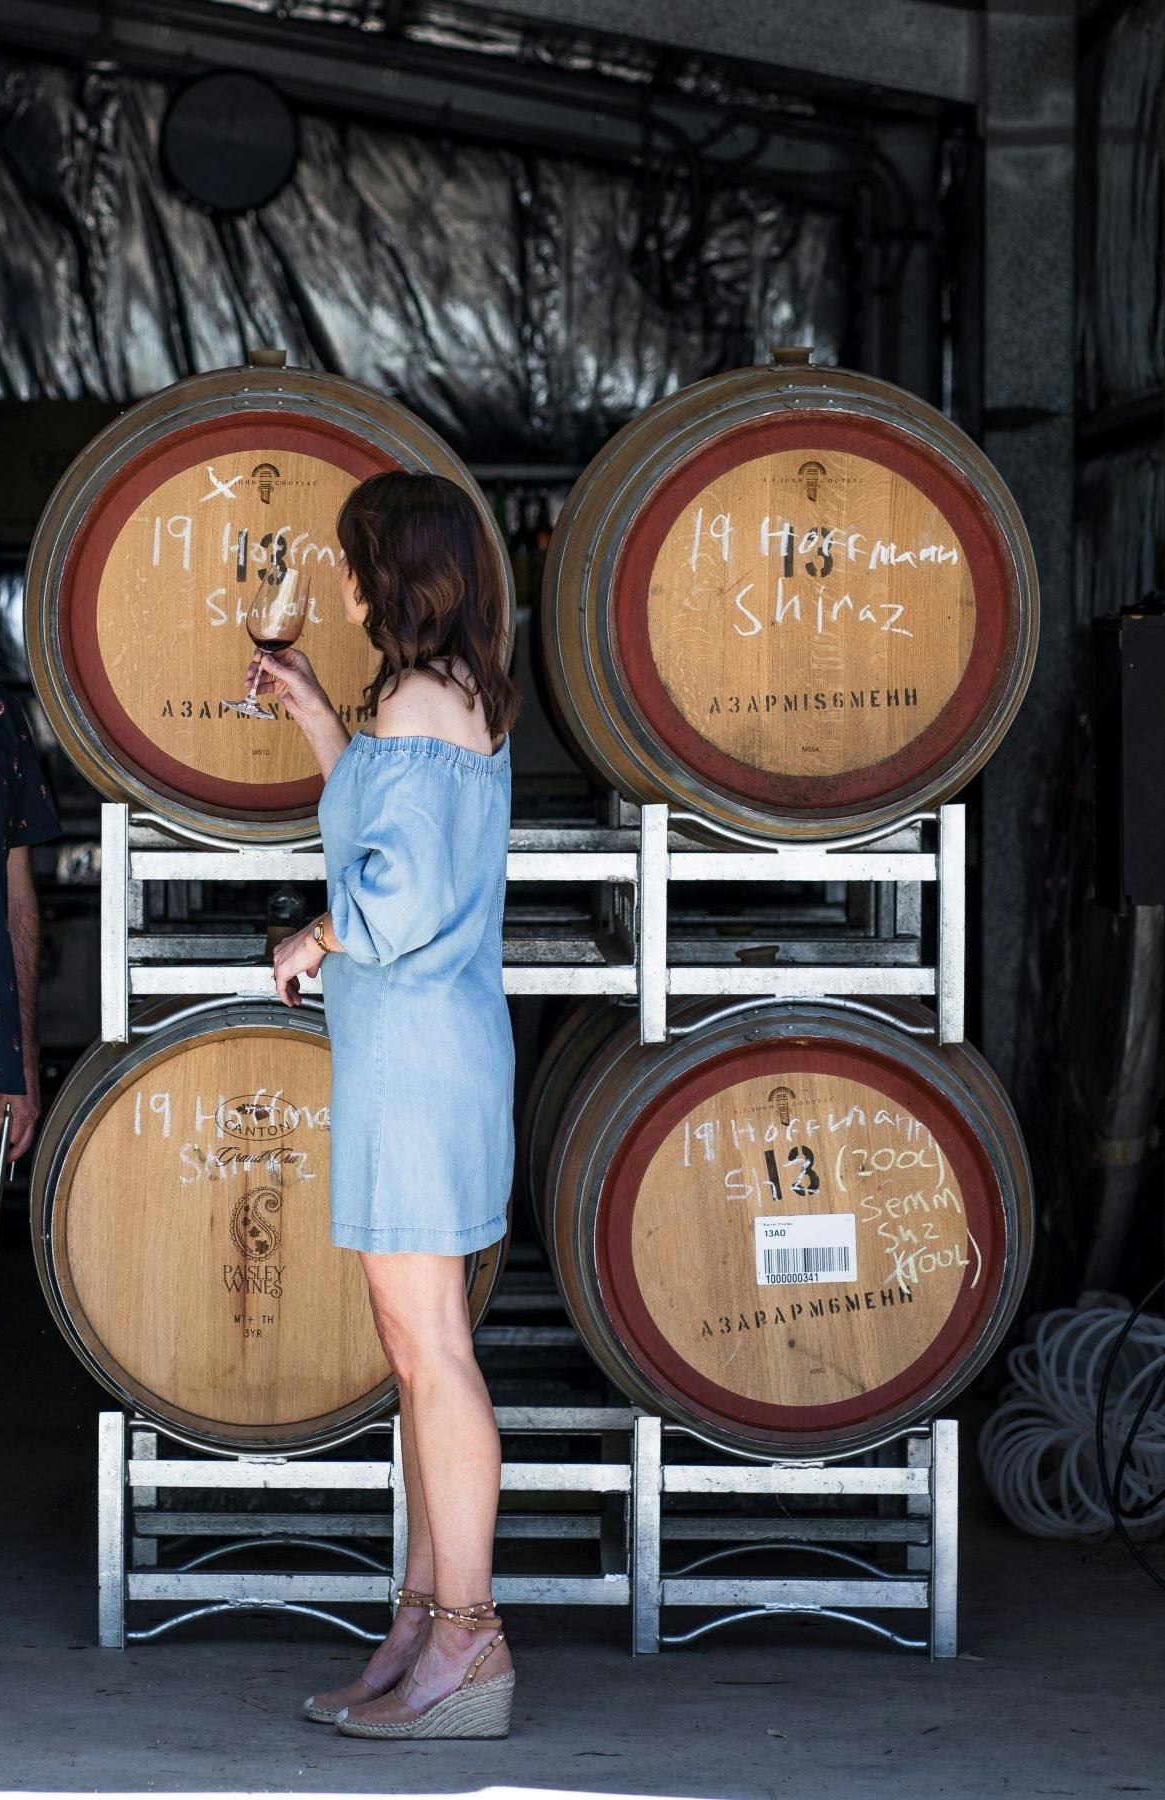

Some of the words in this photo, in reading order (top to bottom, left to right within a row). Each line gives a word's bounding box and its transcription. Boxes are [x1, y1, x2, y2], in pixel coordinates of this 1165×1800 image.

[153, 514, 192, 572] 19
[690, 507, 734, 573] 19
[784, 525, 834, 578] 13
[733, 577, 914, 638] Shiraz
[134, 1091, 173, 1139] 19
[224, 1118, 292, 1138] CANTON
[215, 1146, 264, 1168] Grand
[267, 1147, 300, 1165] Cru
[684, 1120, 717, 1167] 19
[764, 1145, 820, 1201] 13
[223, 1264, 286, 1281] PAISLEY
[223, 1279, 283, 1299] WINES
[765, 1272, 819, 1284] 1000000341
[244, 1328, 263, 1338] 3YR
[261, 1315, 274, 1325] TH
